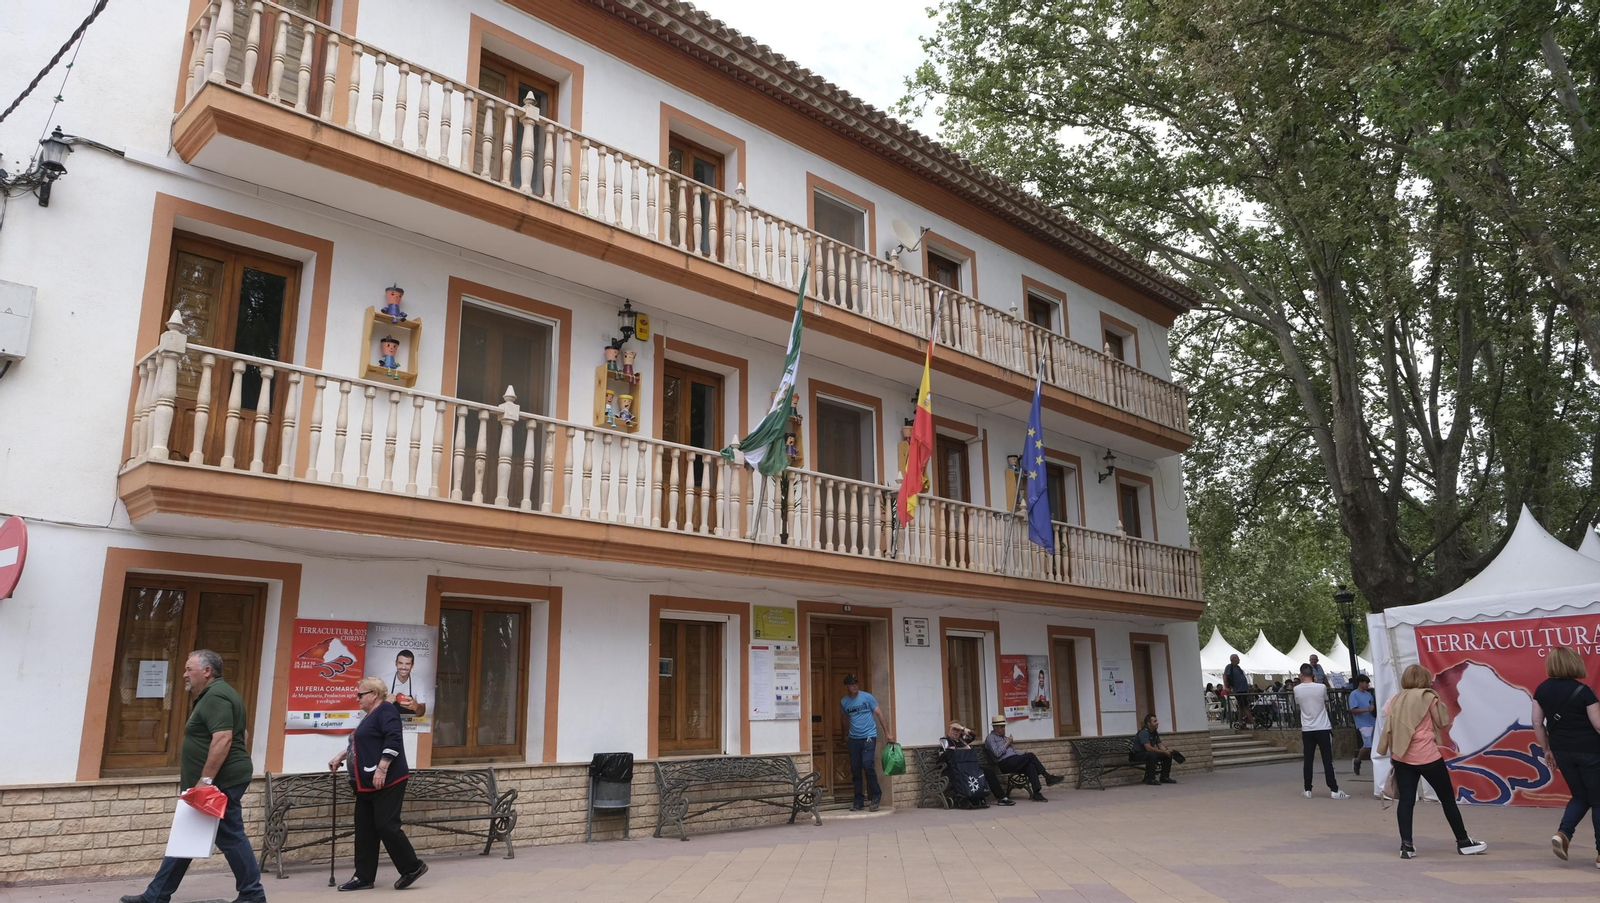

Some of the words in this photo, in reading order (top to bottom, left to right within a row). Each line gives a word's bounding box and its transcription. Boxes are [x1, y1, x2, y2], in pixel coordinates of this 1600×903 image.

[299, 626, 354, 636] TERRACULTURA
[377, 639, 399, 647] SHOW
[399, 640, 429, 648] COOKING
